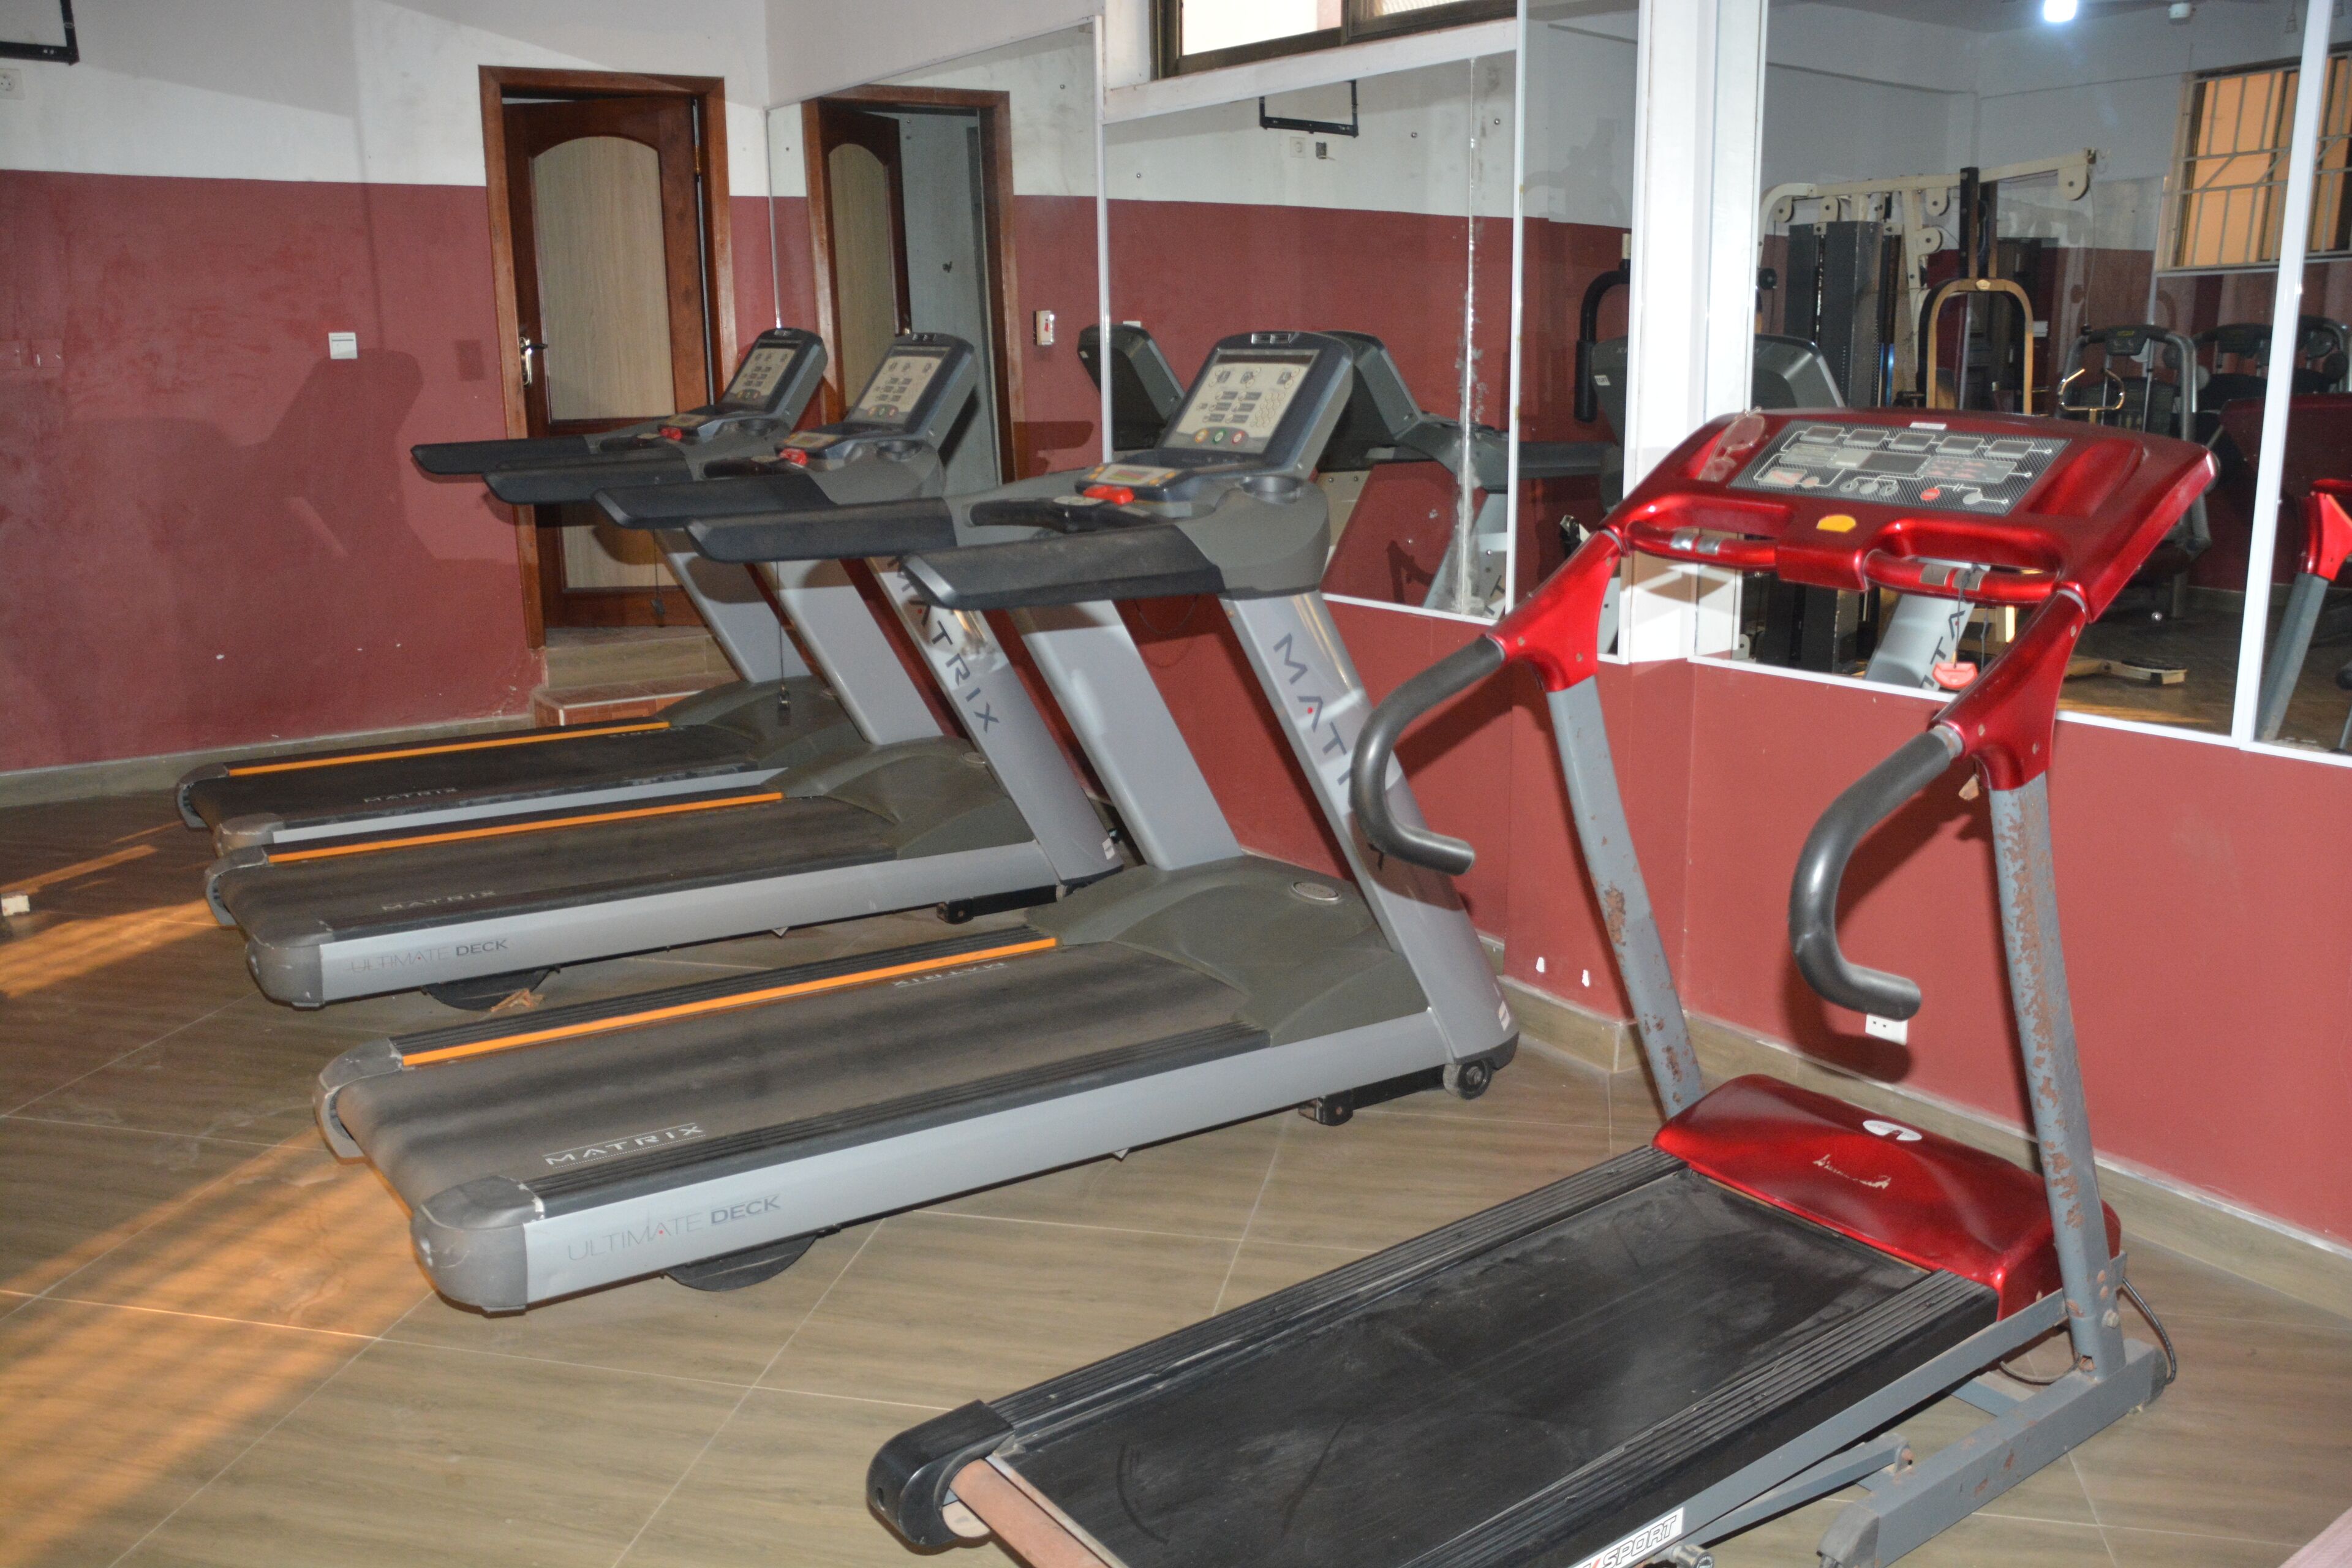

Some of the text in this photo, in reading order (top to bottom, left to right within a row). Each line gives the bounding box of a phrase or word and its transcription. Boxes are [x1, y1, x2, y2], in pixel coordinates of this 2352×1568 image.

[382, 891, 496, 911] MATRIX
[351, 939, 508, 973] ULTIMATE DECK
[544, 1125, 704, 1166] MATRIX
[568, 1195, 781, 1261] ULTIMATE DECK
